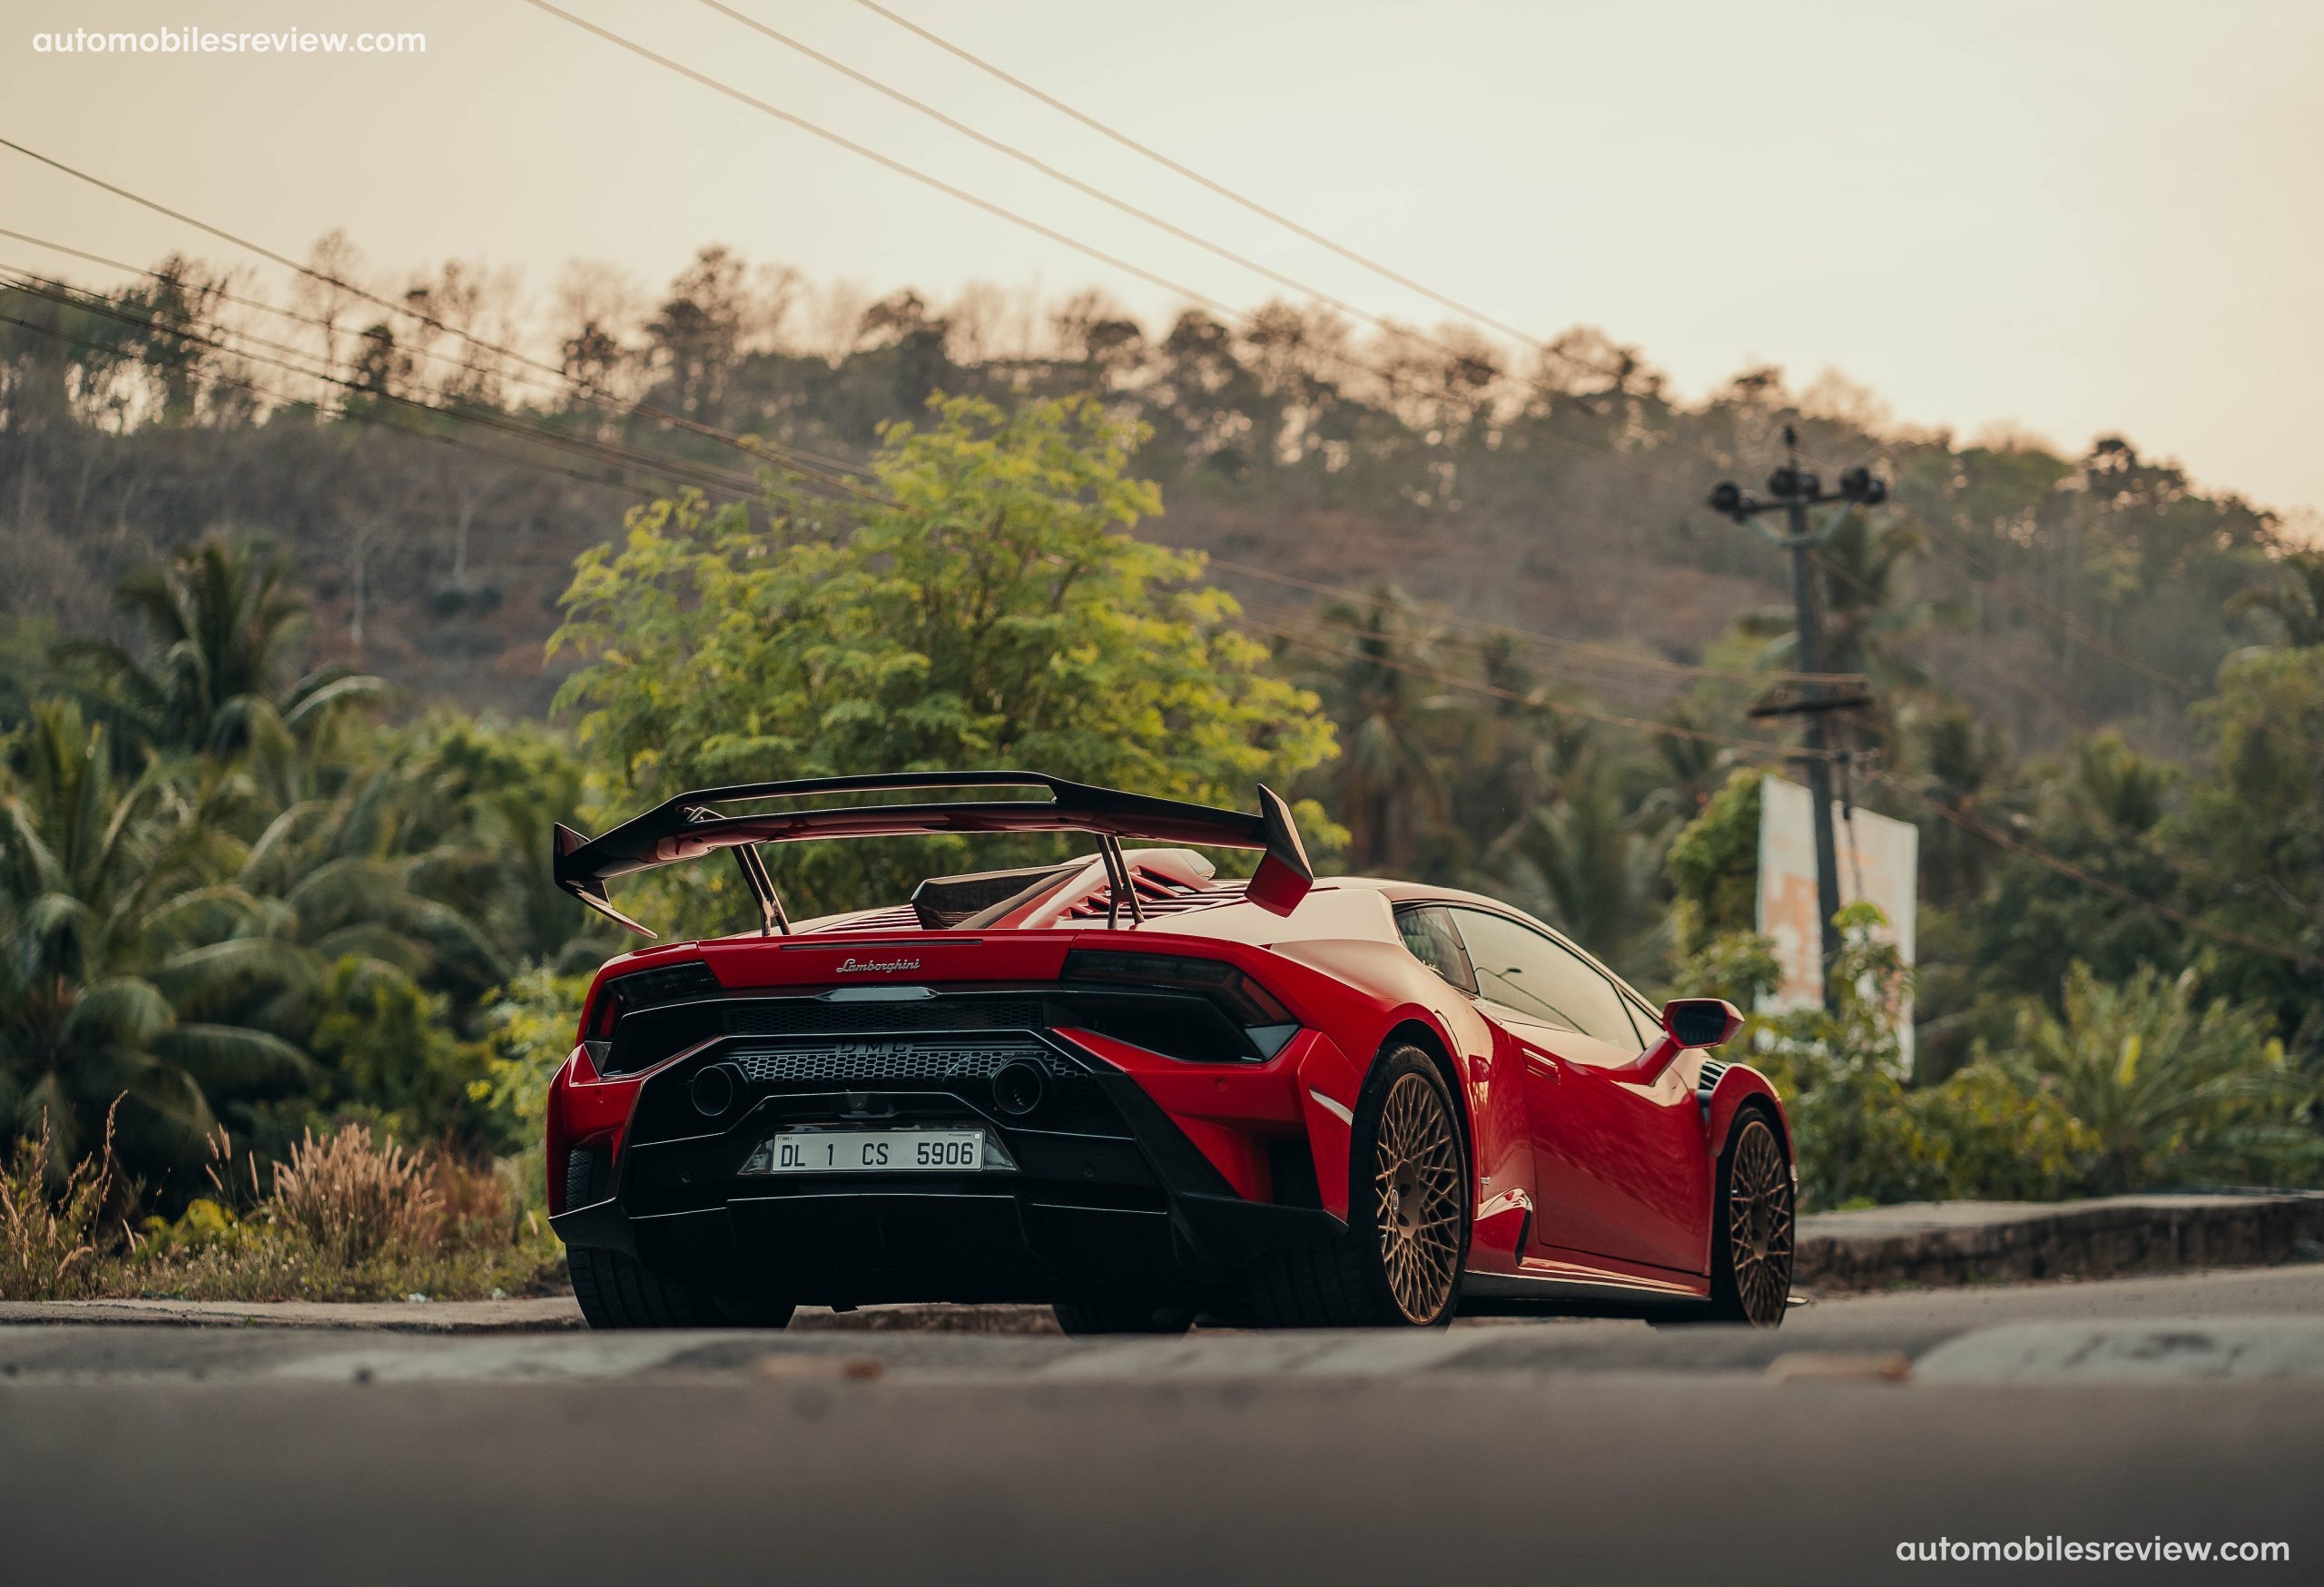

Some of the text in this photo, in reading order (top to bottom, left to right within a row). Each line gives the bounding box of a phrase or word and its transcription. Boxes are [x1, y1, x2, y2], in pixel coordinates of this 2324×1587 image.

[835, 958, 921, 973] Lamborghini
[781, 1142, 974, 1168] DL 1 CS 5906
